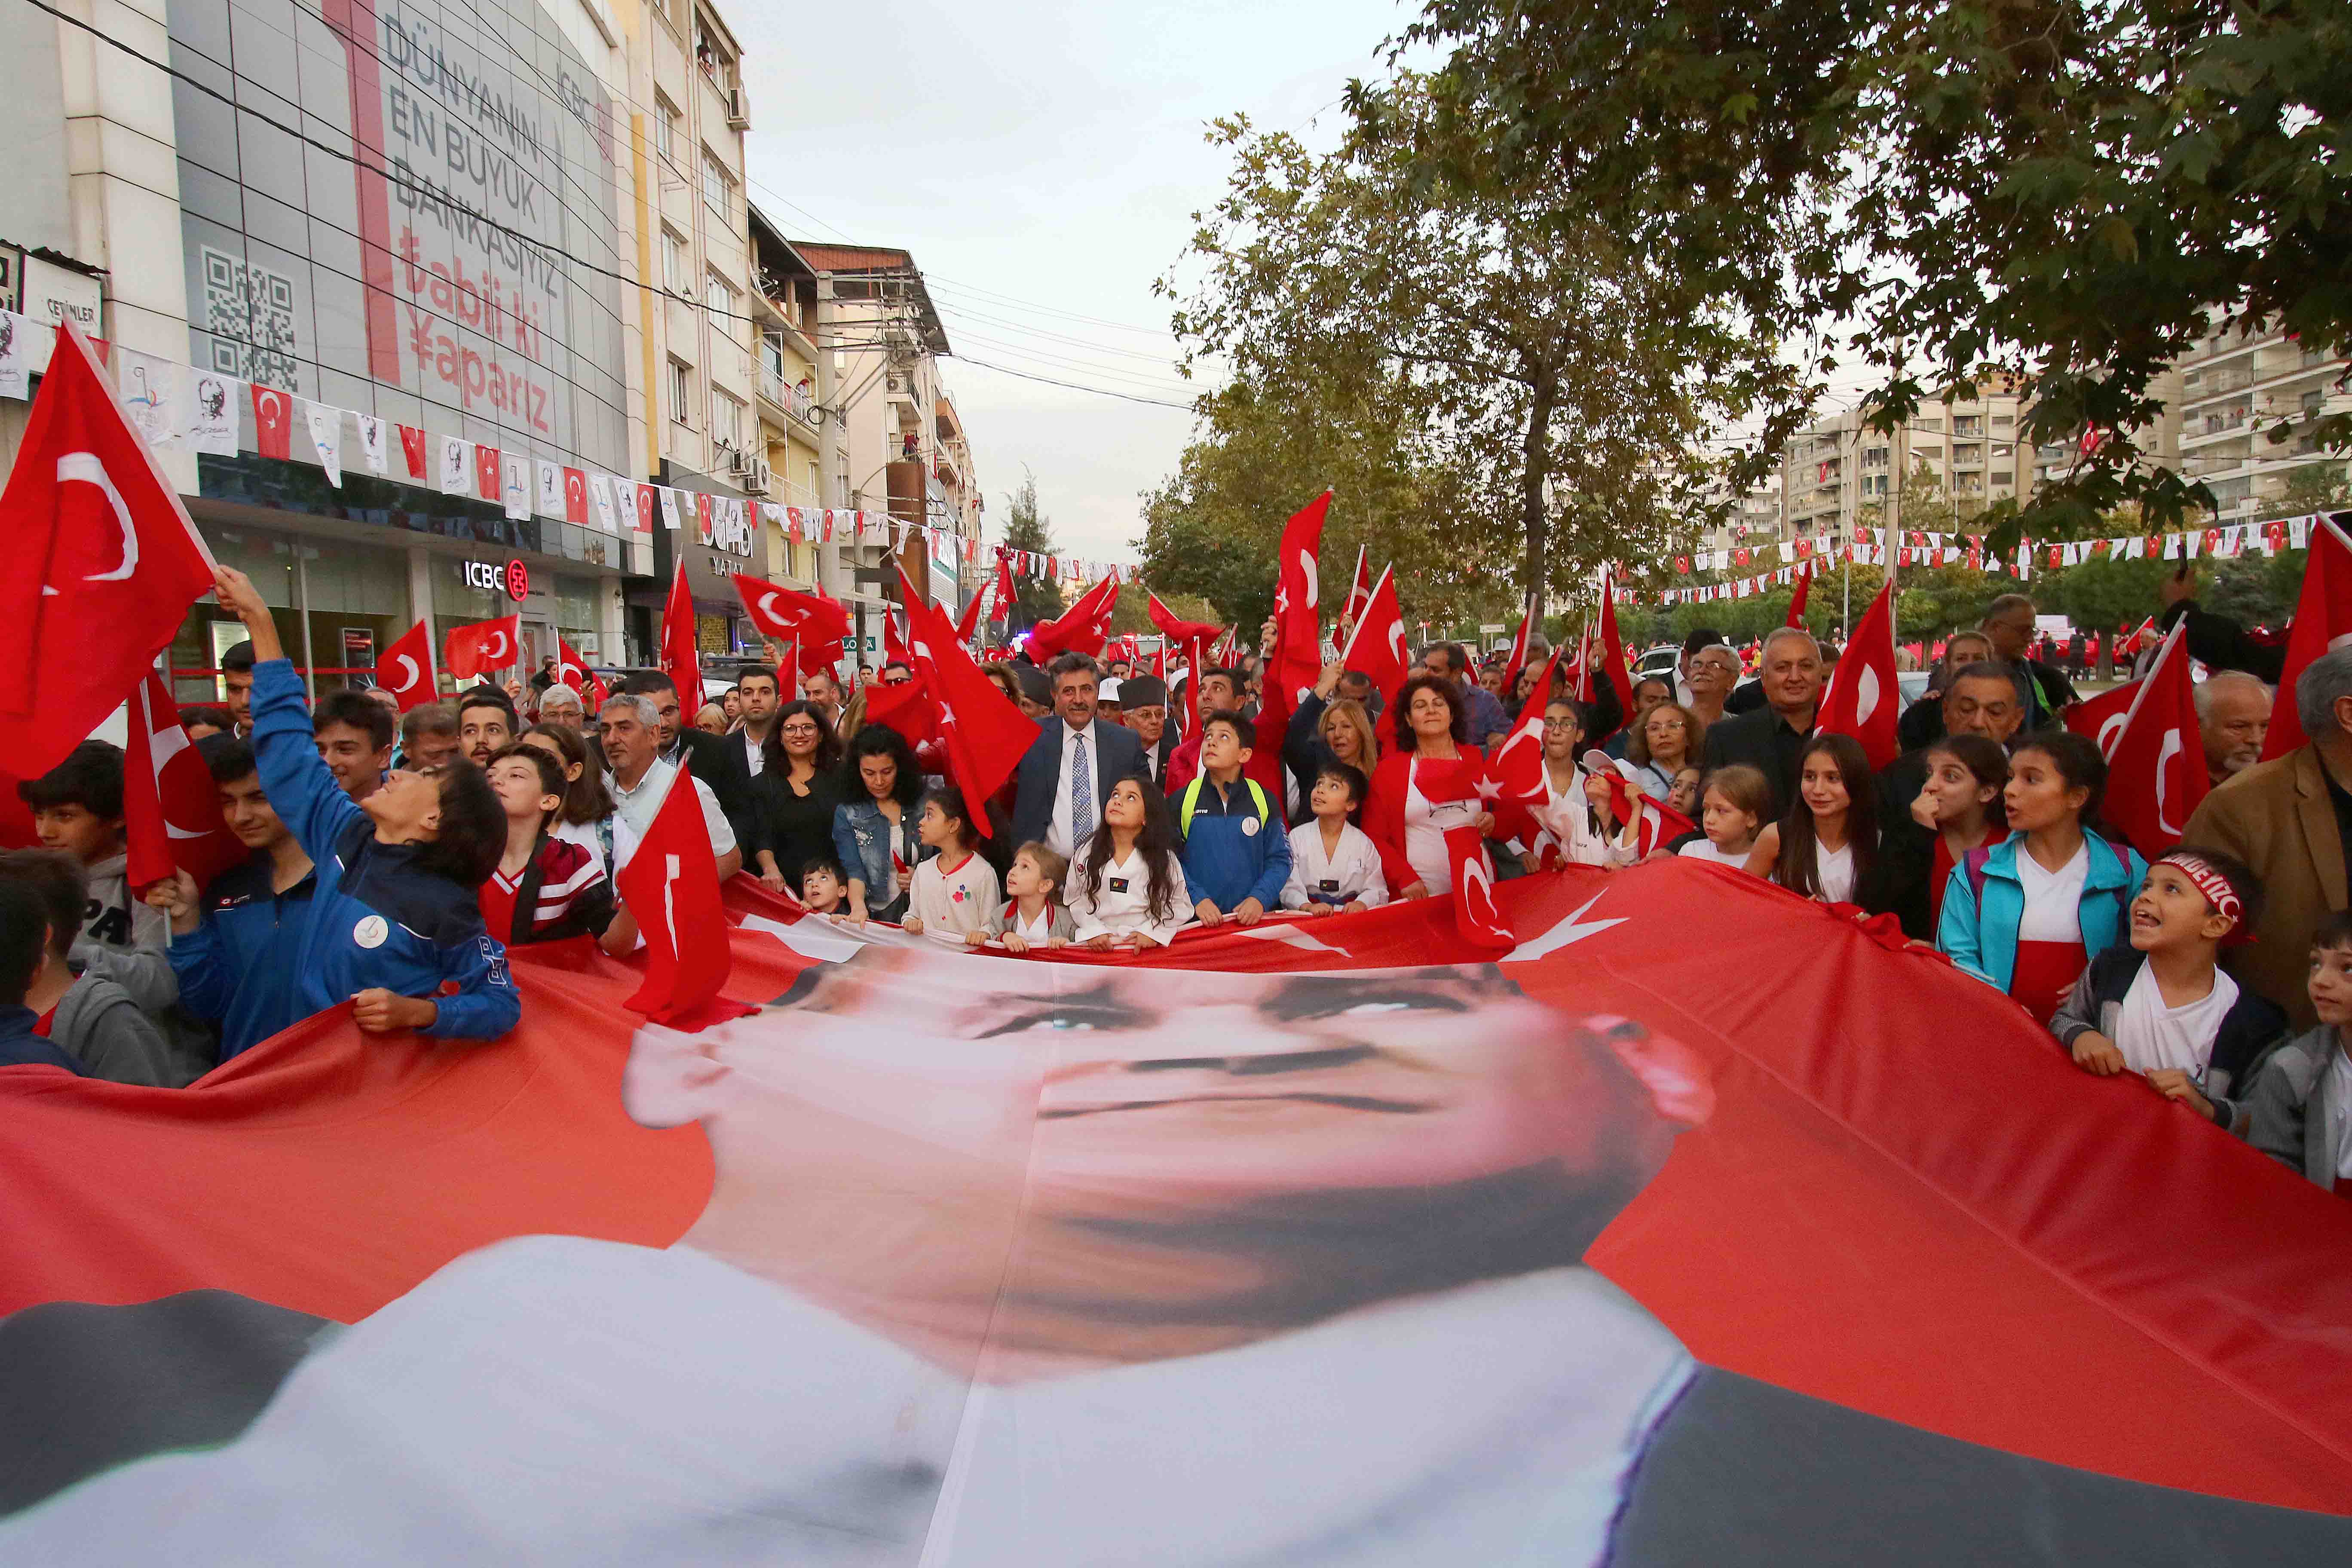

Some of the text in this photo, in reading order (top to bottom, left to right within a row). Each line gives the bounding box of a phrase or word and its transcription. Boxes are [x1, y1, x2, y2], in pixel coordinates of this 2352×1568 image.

[385, 13, 538, 163] DÜNYANIN
[390, 84, 536, 224] EN BÜYÜK
[394, 155, 558, 297] BANKASIYIZ
[513, 290, 540, 362] ki
[465, 560, 505, 591] ICBC
